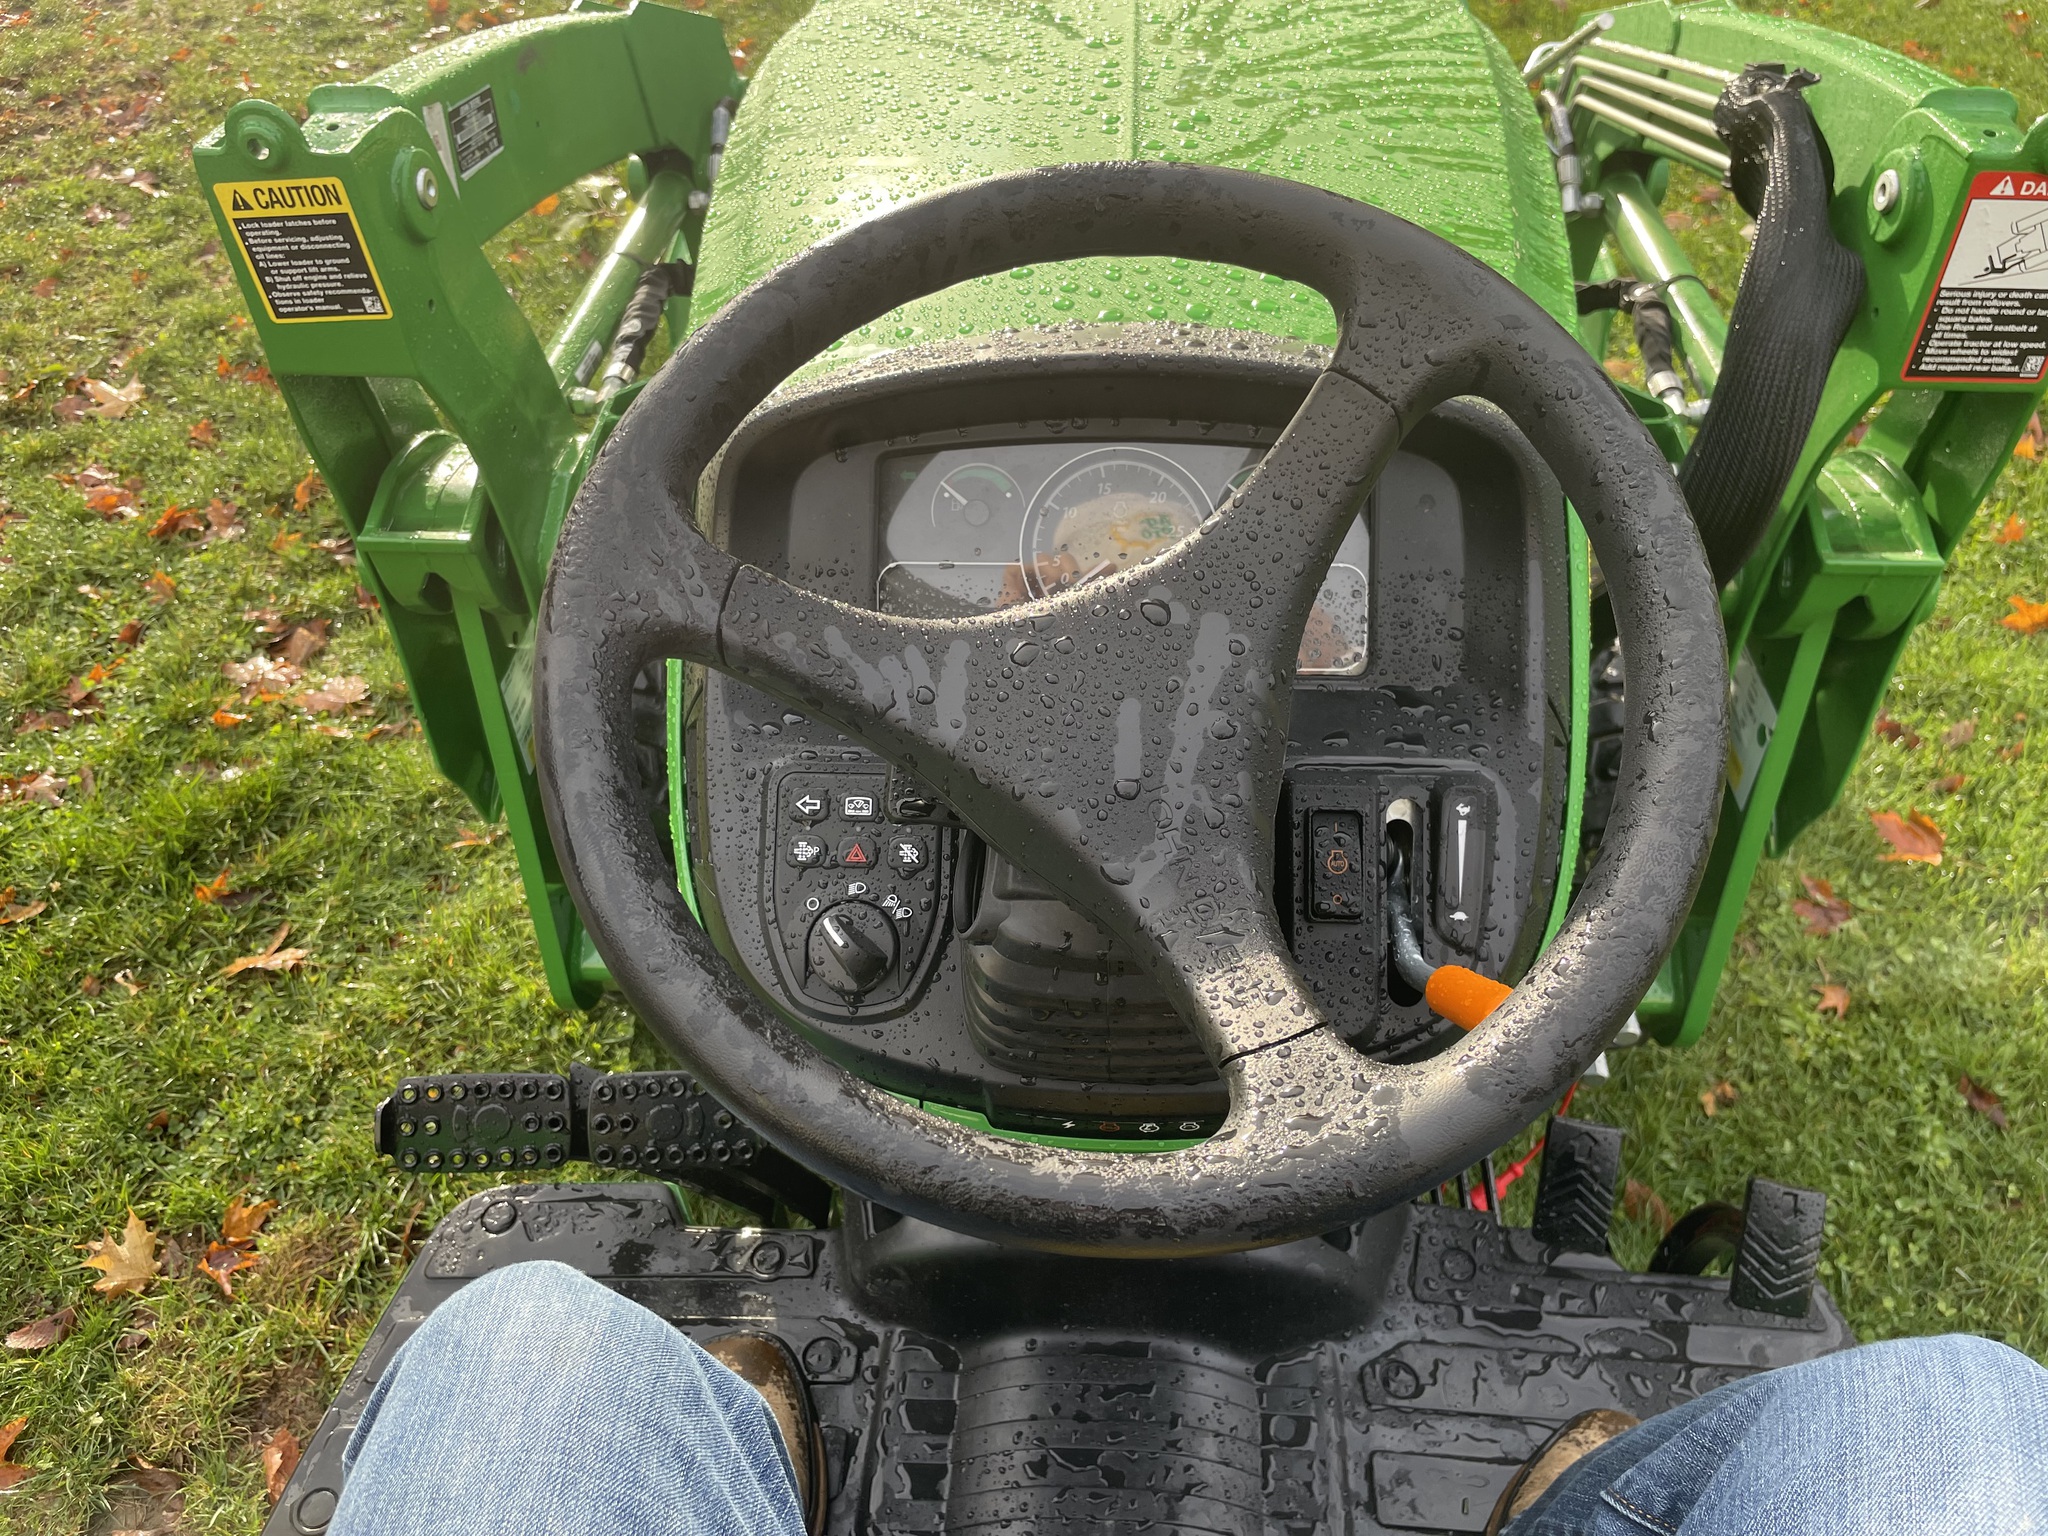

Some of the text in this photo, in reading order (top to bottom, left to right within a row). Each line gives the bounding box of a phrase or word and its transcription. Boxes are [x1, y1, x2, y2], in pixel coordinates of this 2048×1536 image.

[2020, 181, 2048, 196] DA
[253, 184, 342, 209] CAUTION
[241, 218, 337, 229] Lock loader latches before
[245, 229, 282, 237] operating.
[248, 237, 272, 245] Before
[309, 234, 344, 243] adjusting
[251, 244, 290, 253] equipment
[300, 242, 351, 250] disconnecting
[255, 252, 265, 260] oil
[259, 260, 268, 269] A)
[268, 260, 289, 268] Lower
[290, 259, 314, 267] loader
[324, 257, 351, 266] ground
[280, 266, 308, 276] support
[274, 274, 292, 282] Shut
[292, 273, 303, 281] off
[303, 273, 328, 281] engine
[329, 272, 343, 280] and
[343, 272, 368, 280] relieve
[276, 281, 344, 291] hydraulic pressure.
[271, 290, 301, 298] Observe
[301, 288, 324, 297] safety
[1939, 289, 1972, 298] Serious
[1972, 290, 1997, 300] injury
[1997, 291, 2008, 299] or
[2008, 291, 2033, 299] death
[274, 298, 294, 306] tions
[302, 296, 325, 304] loader
[1935, 298, 2021, 308] result from rollovers.
[1940, 306, 1954, 315] Do
[1954, 306, 1970, 315] not
[1970, 307, 1999, 316] handle
[2000, 307, 2026, 316] round
[2026, 308, 2037, 316] or
[1937, 315, 1967, 325] square
[1934, 323, 1952, 331] Use
[1975, 324, 1993, 332] and
[1993, 324, 2028, 333] seatbelt
[2027, 325, 2039, 333] at
[1928, 339, 2047, 351] Operate tractor at low speed.
[1924, 347, 2019, 357] Move wheels to widest
[1921, 356, 1982, 364] recommended
[1918, 363, 2021, 373] Add required rear ballast.
[1097, 482, 1112, 496] 15
[1149, 491, 1167, 504] 20
[1062, 506, 1078, 520] 10
[1168, 525, 1184, 538] 25
[1052, 554, 1061, 567] 5
[1060, 572, 1070, 586] 0
